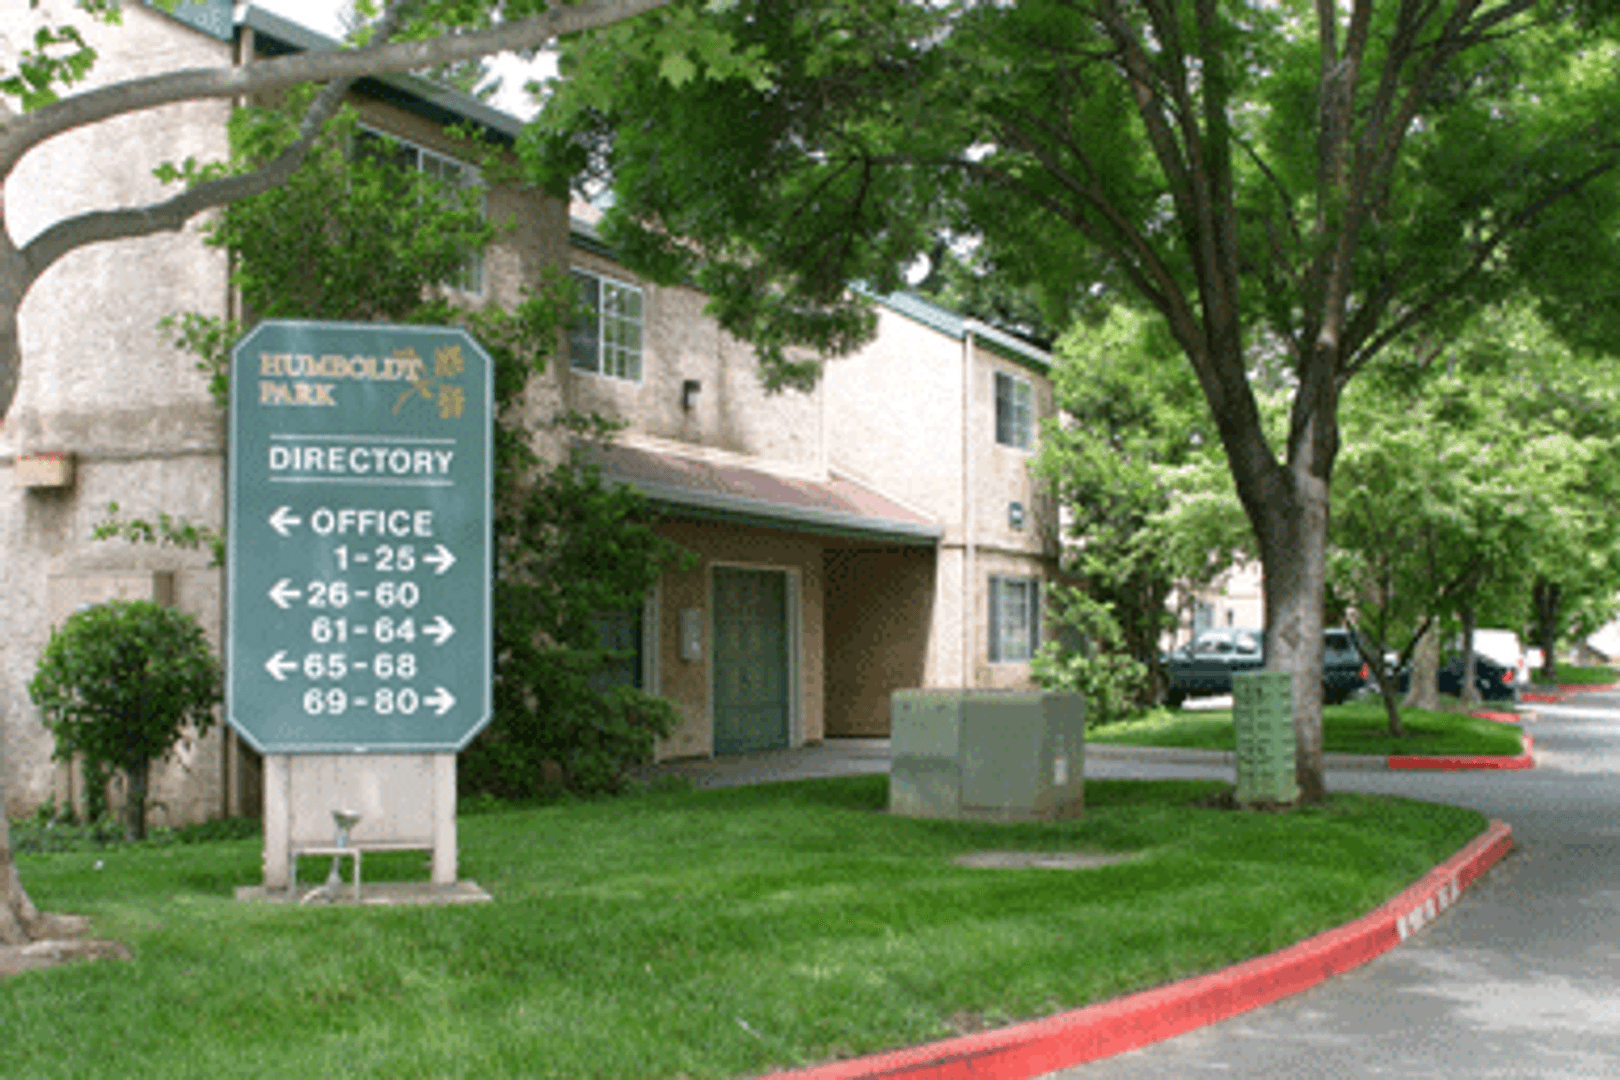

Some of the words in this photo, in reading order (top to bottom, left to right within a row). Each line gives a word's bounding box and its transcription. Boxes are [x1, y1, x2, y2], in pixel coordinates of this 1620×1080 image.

[259, 351, 424, 381] HUMBOLDT
[259, 380, 338, 406] PARK
[269, 446, 453, 474] DIRECTORY
[311, 508, 433, 537] OFFICE
